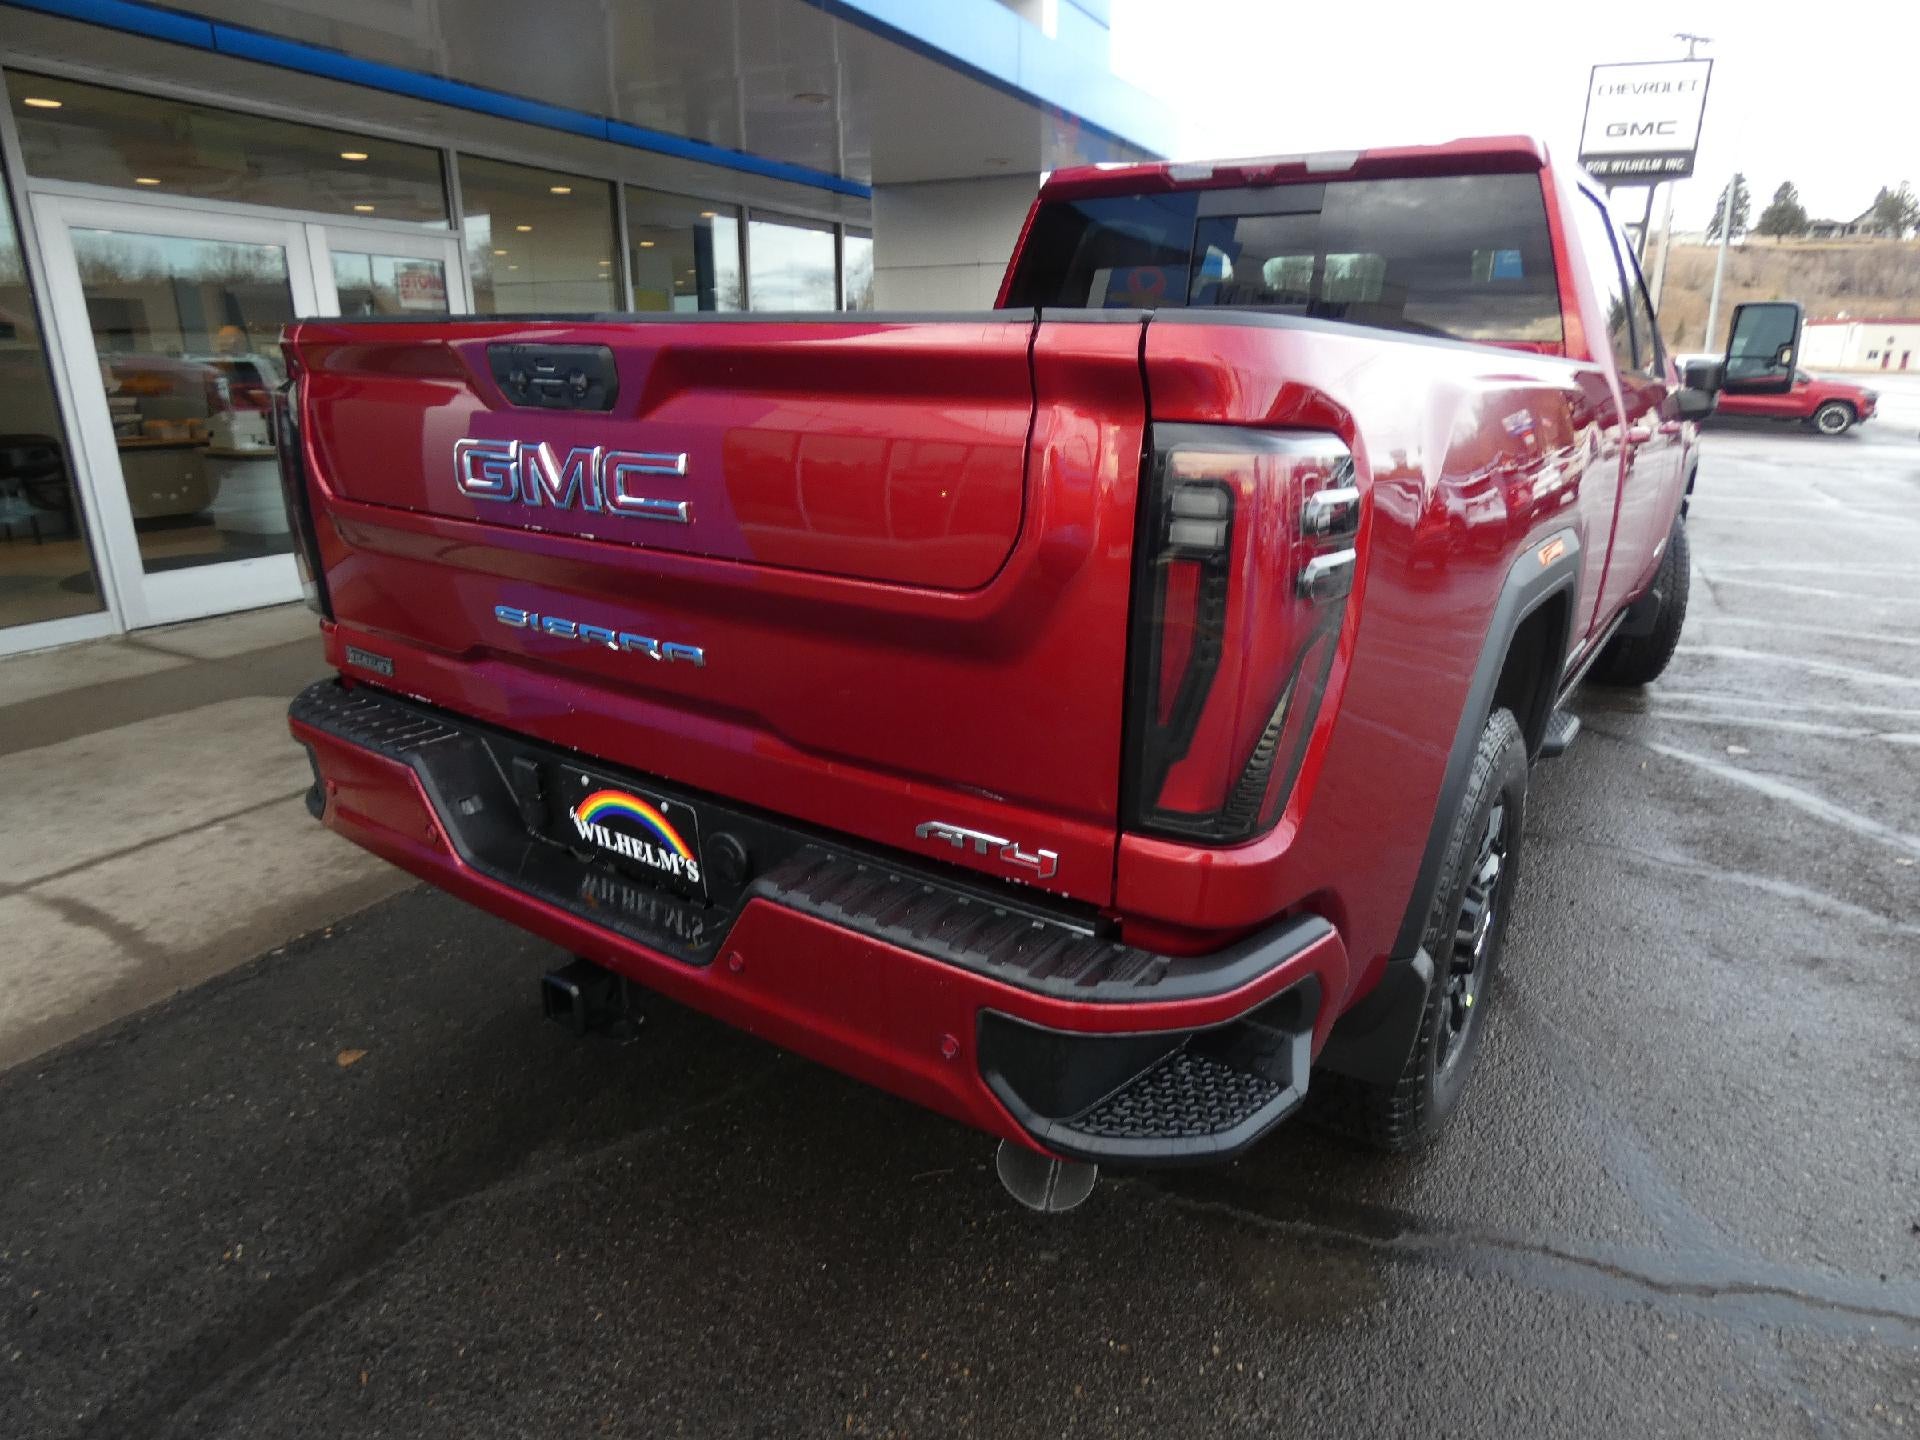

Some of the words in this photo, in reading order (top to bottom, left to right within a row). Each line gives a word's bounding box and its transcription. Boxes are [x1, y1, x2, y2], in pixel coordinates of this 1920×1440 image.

[1597, 79, 1699, 96] CHEVROLET
[1606, 120, 1678, 137] GMC
[1610, 158, 1662, 174] WILHELM
[453, 438, 690, 524] GMC
[494, 604, 706, 668] SIERRA
[915, 821, 1059, 879] AT4
